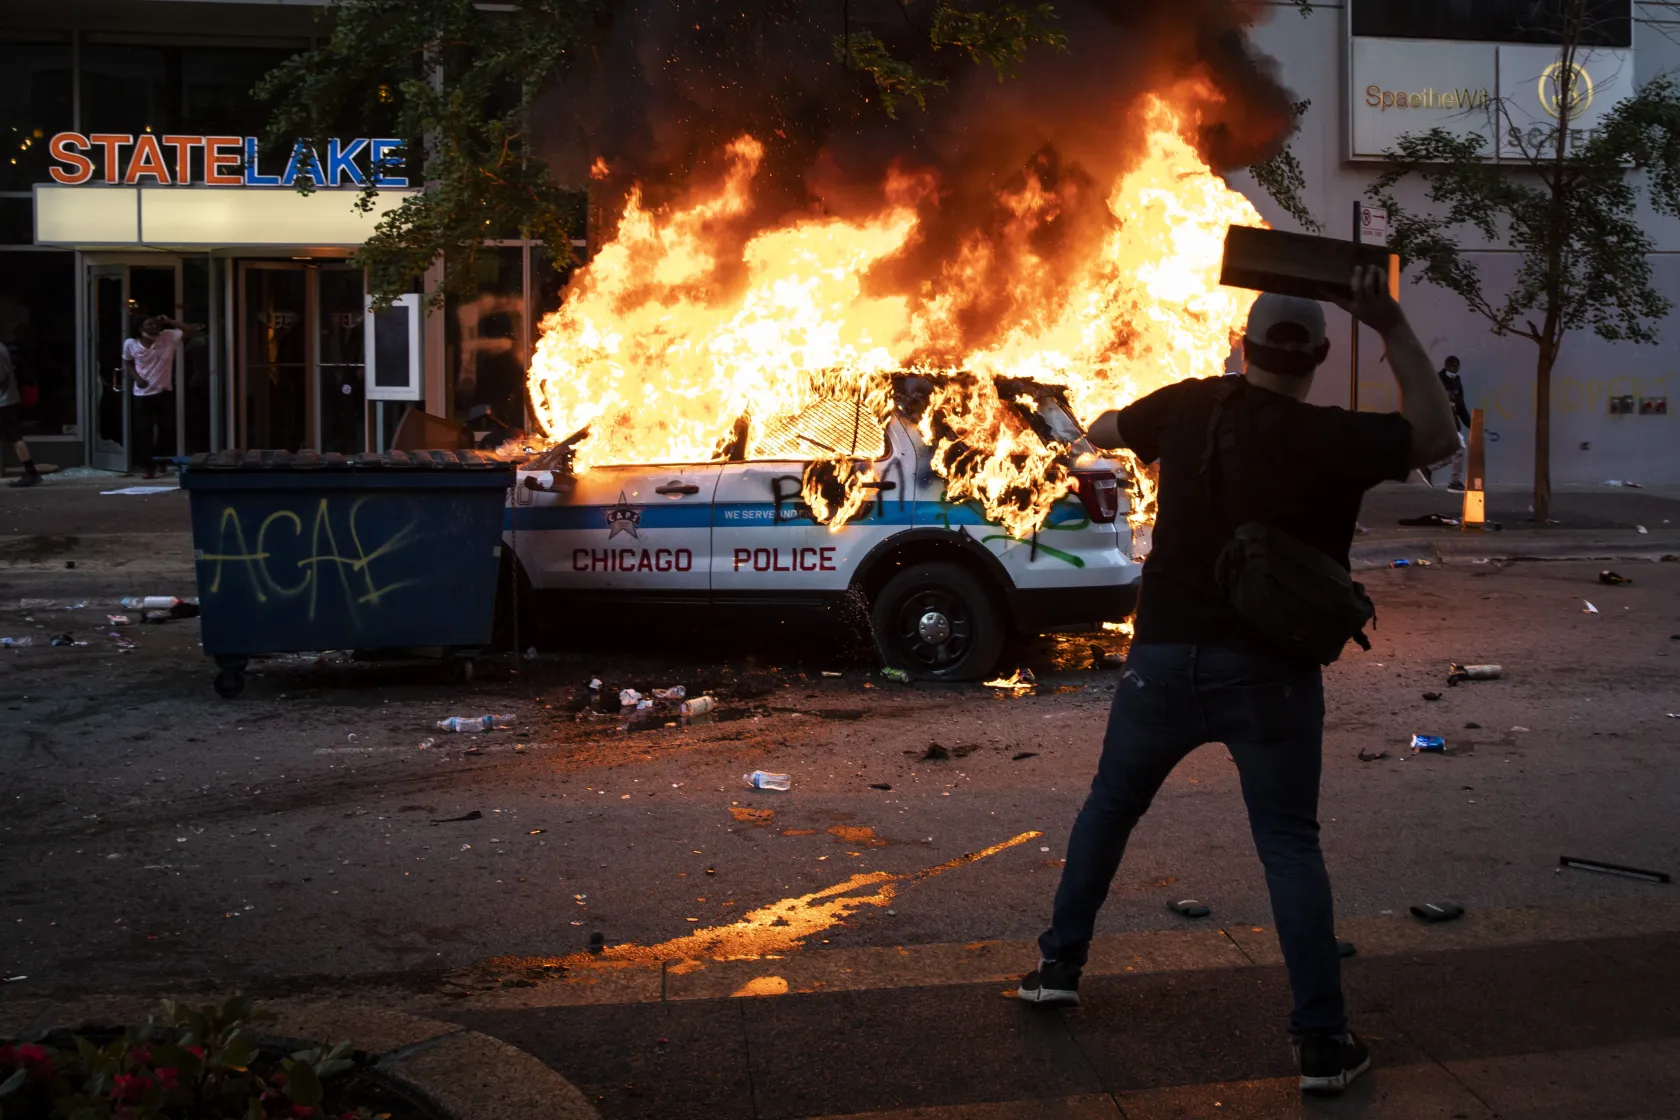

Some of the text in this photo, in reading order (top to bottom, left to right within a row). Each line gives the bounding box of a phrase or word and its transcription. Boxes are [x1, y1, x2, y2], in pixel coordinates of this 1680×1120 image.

[49, 132, 409, 187] STATE LAKE
[608, 511, 639, 522] CAPS
[724, 510, 741, 519] WE
[741, 510, 775, 519] SERVE
[572, 546, 837, 572] CHICAGO POLICE
